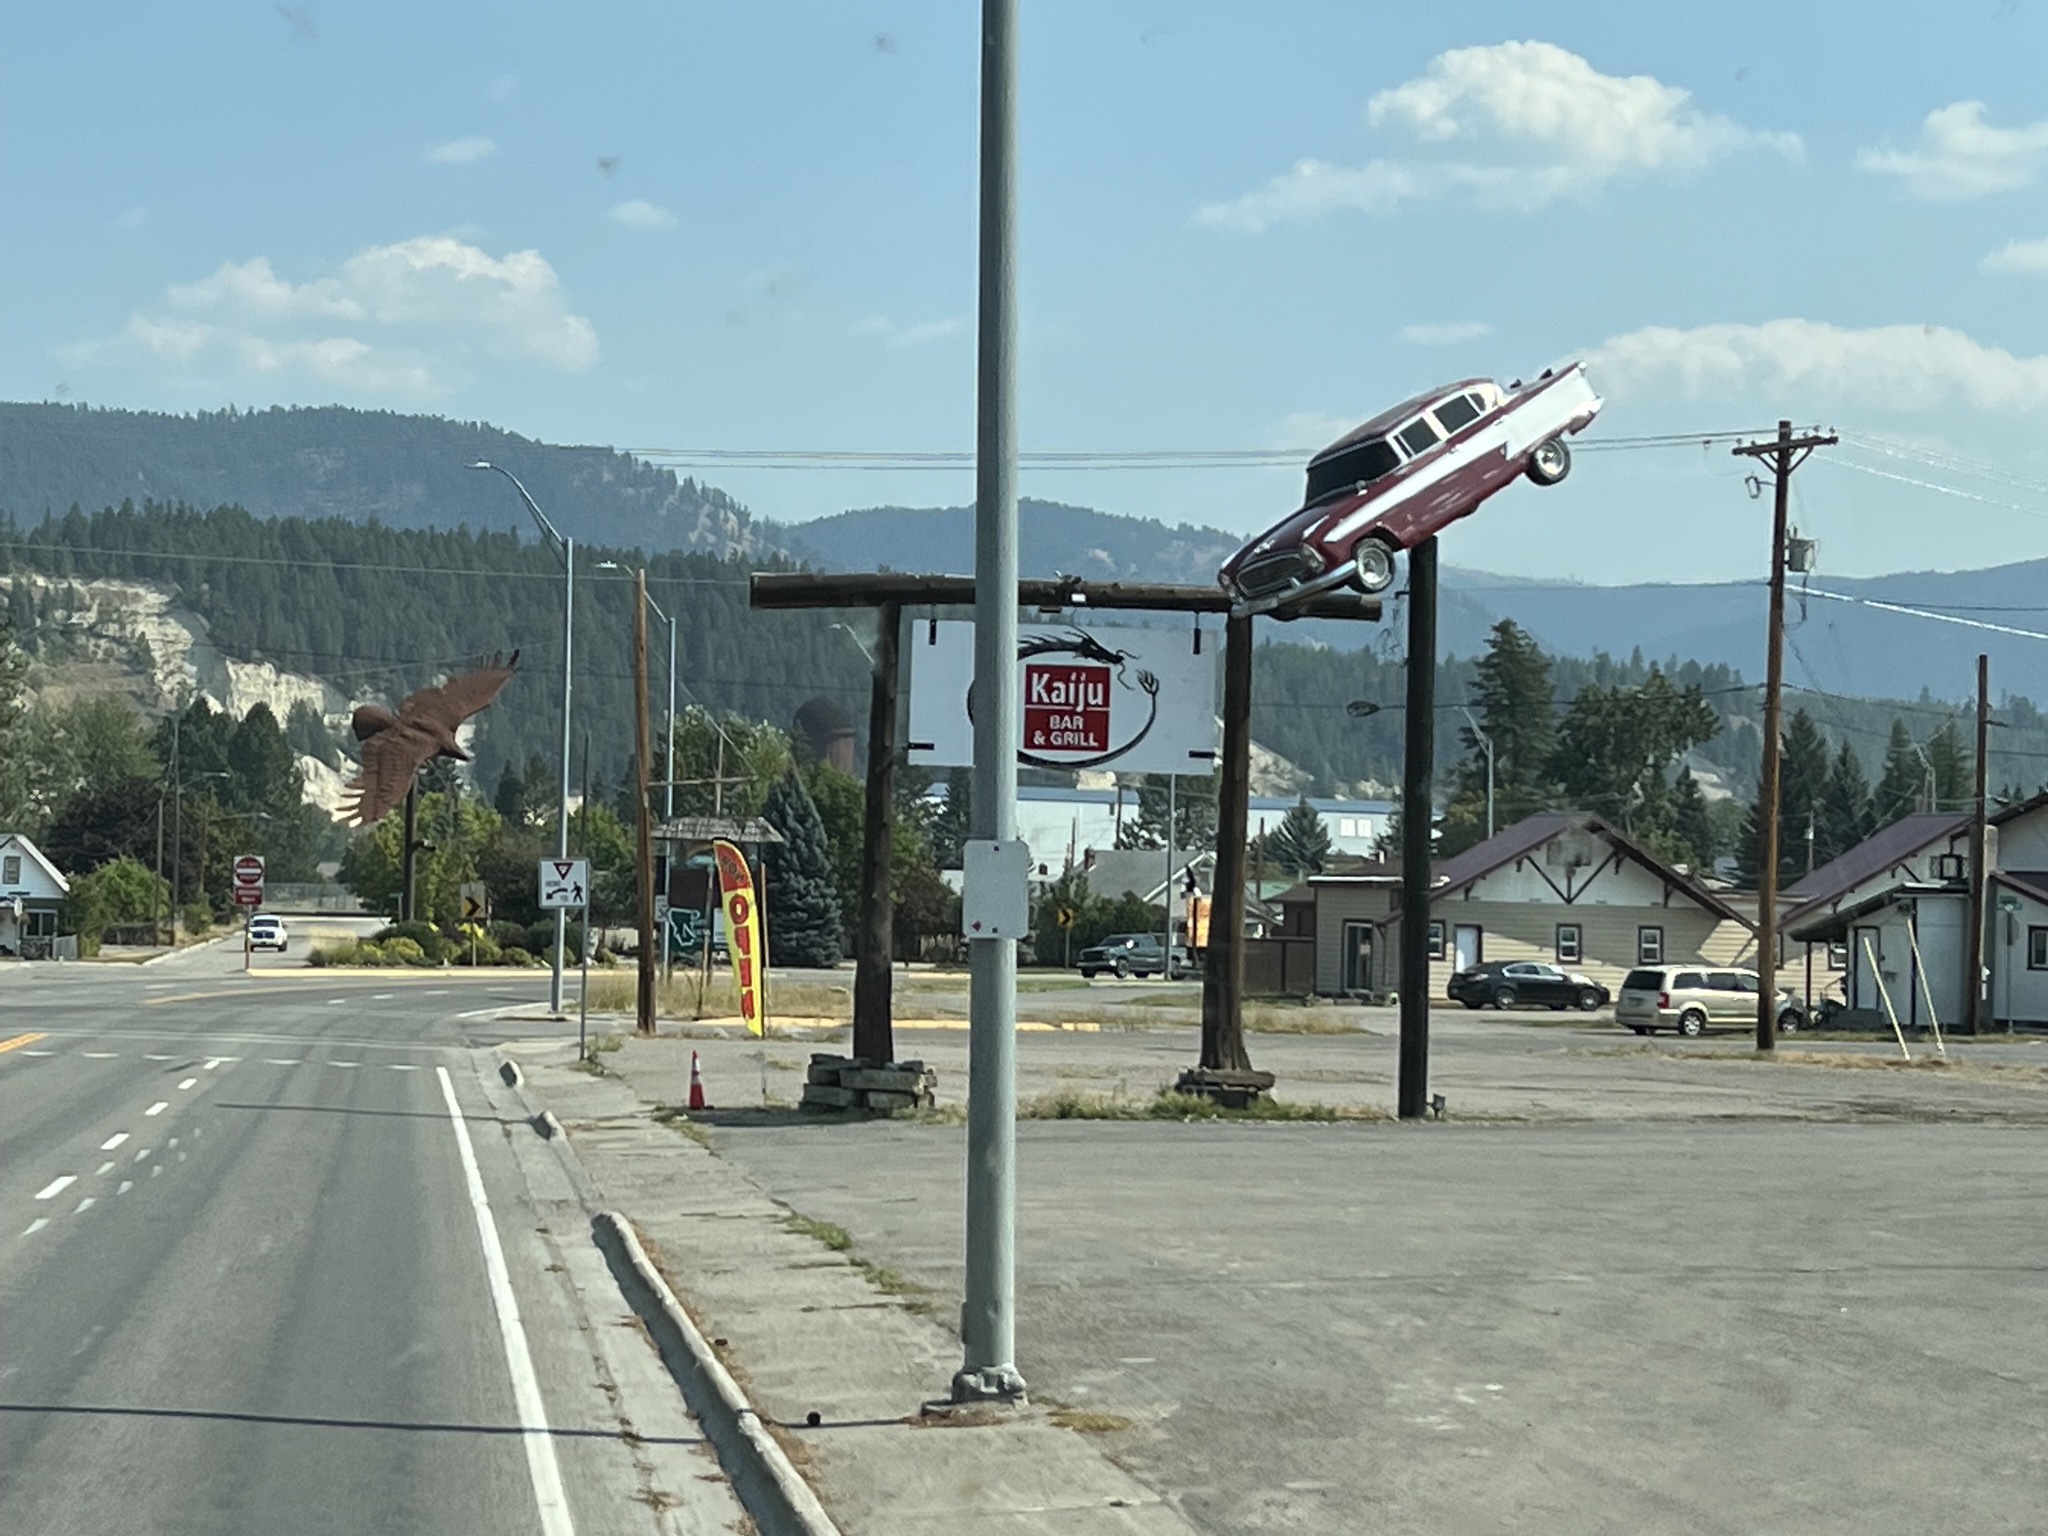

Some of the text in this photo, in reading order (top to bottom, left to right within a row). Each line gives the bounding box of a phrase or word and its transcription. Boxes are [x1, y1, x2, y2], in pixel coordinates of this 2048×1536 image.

[1031, 671, 1104, 713] Kaiju
[1049, 714, 1084, 730] BAR
[1033, 729, 1099, 747] & GRILL
